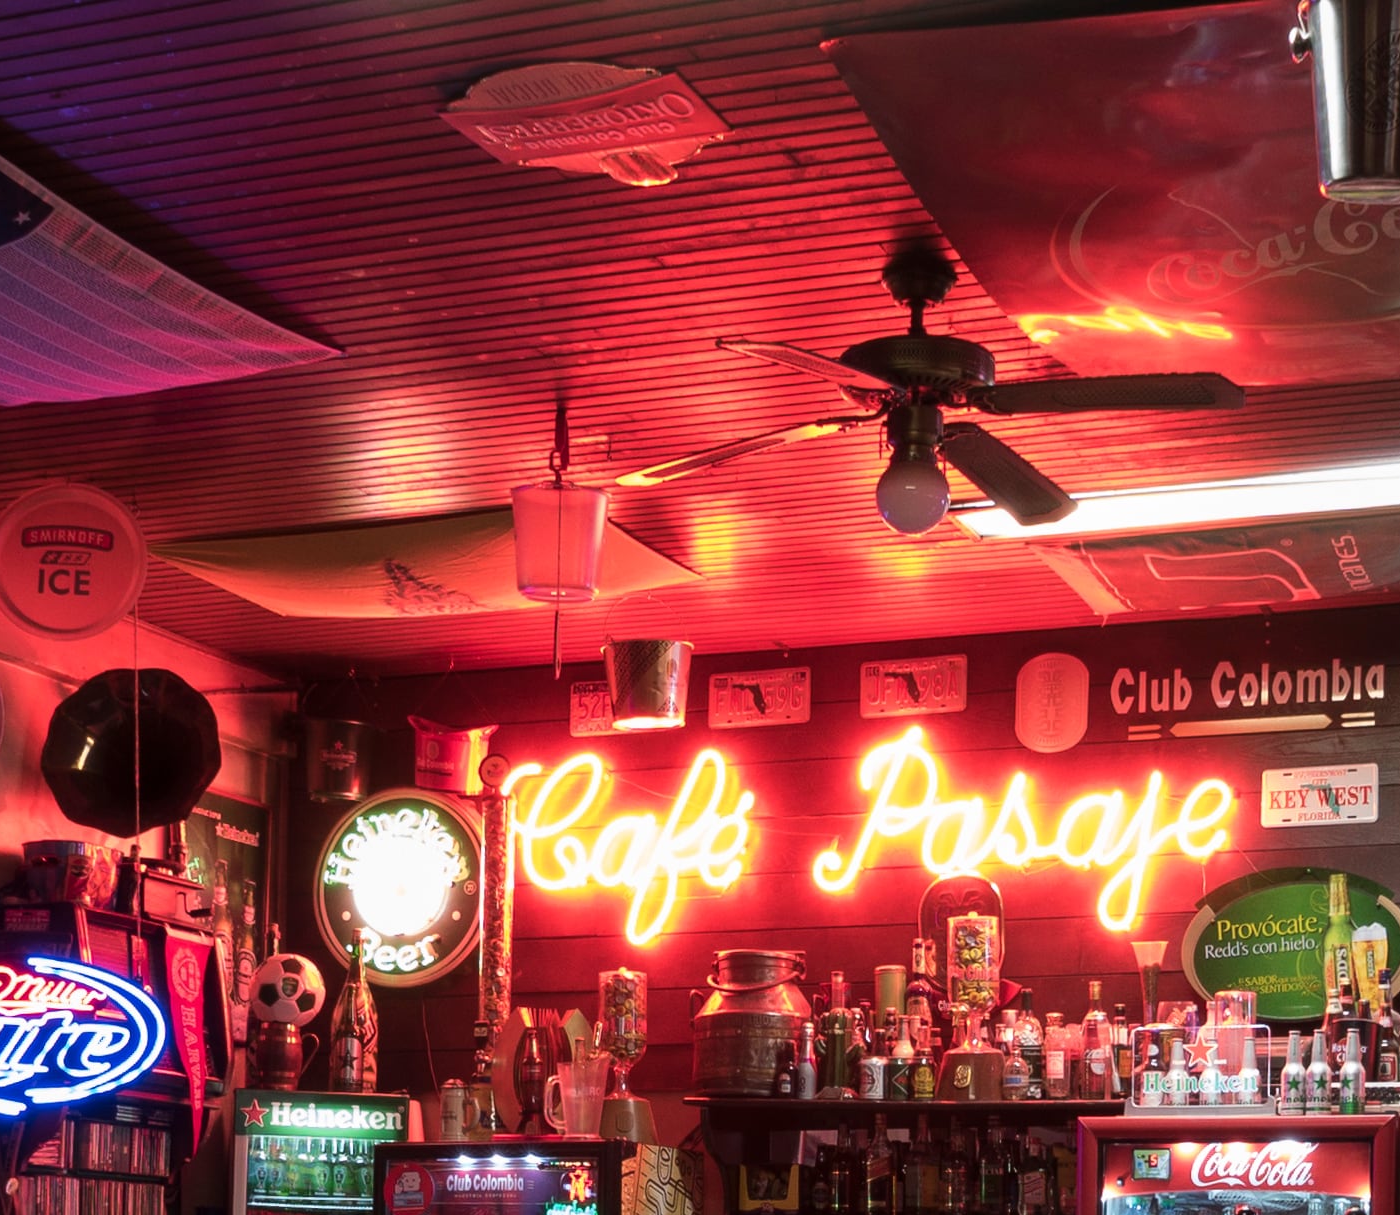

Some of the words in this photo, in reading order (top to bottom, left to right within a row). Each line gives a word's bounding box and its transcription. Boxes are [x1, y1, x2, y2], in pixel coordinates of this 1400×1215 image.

[474, 92, 696, 146] OKTOBERFEST
[627, 120, 676, 138] Club
[525, 129, 626, 151] Colombia
[29, 529, 107, 548] SMIRNOFF
[37, 568, 91, 598] ICE
[1110, 666, 1193, 714] Club
[1211, 659, 1386, 708] Colombia
[1269, 789, 1309, 809] KEY
[1316, 785, 1372, 807] WEST
[1298, 811, 1342, 822] FLORIDA
[502, 748, 755, 946] Café
[812, 726, 1233, 931] Pasaje
[1216, 914, 1324, 941] Provócate,
[1204, 940, 1249, 960] Redd's
[1252, 939, 1277, 955] con
[1281, 936, 1319, 952] hielo.
[1245, 974, 1278, 986] SABOR
[1143, 1071, 1259, 1095] Heineken
[270, 1101, 404, 1131] Heineken
[1190, 1142, 1315, 1188] Coca-Cola
[447, 1174, 471, 1192] Club
[473, 1171, 524, 1192] Colombia
